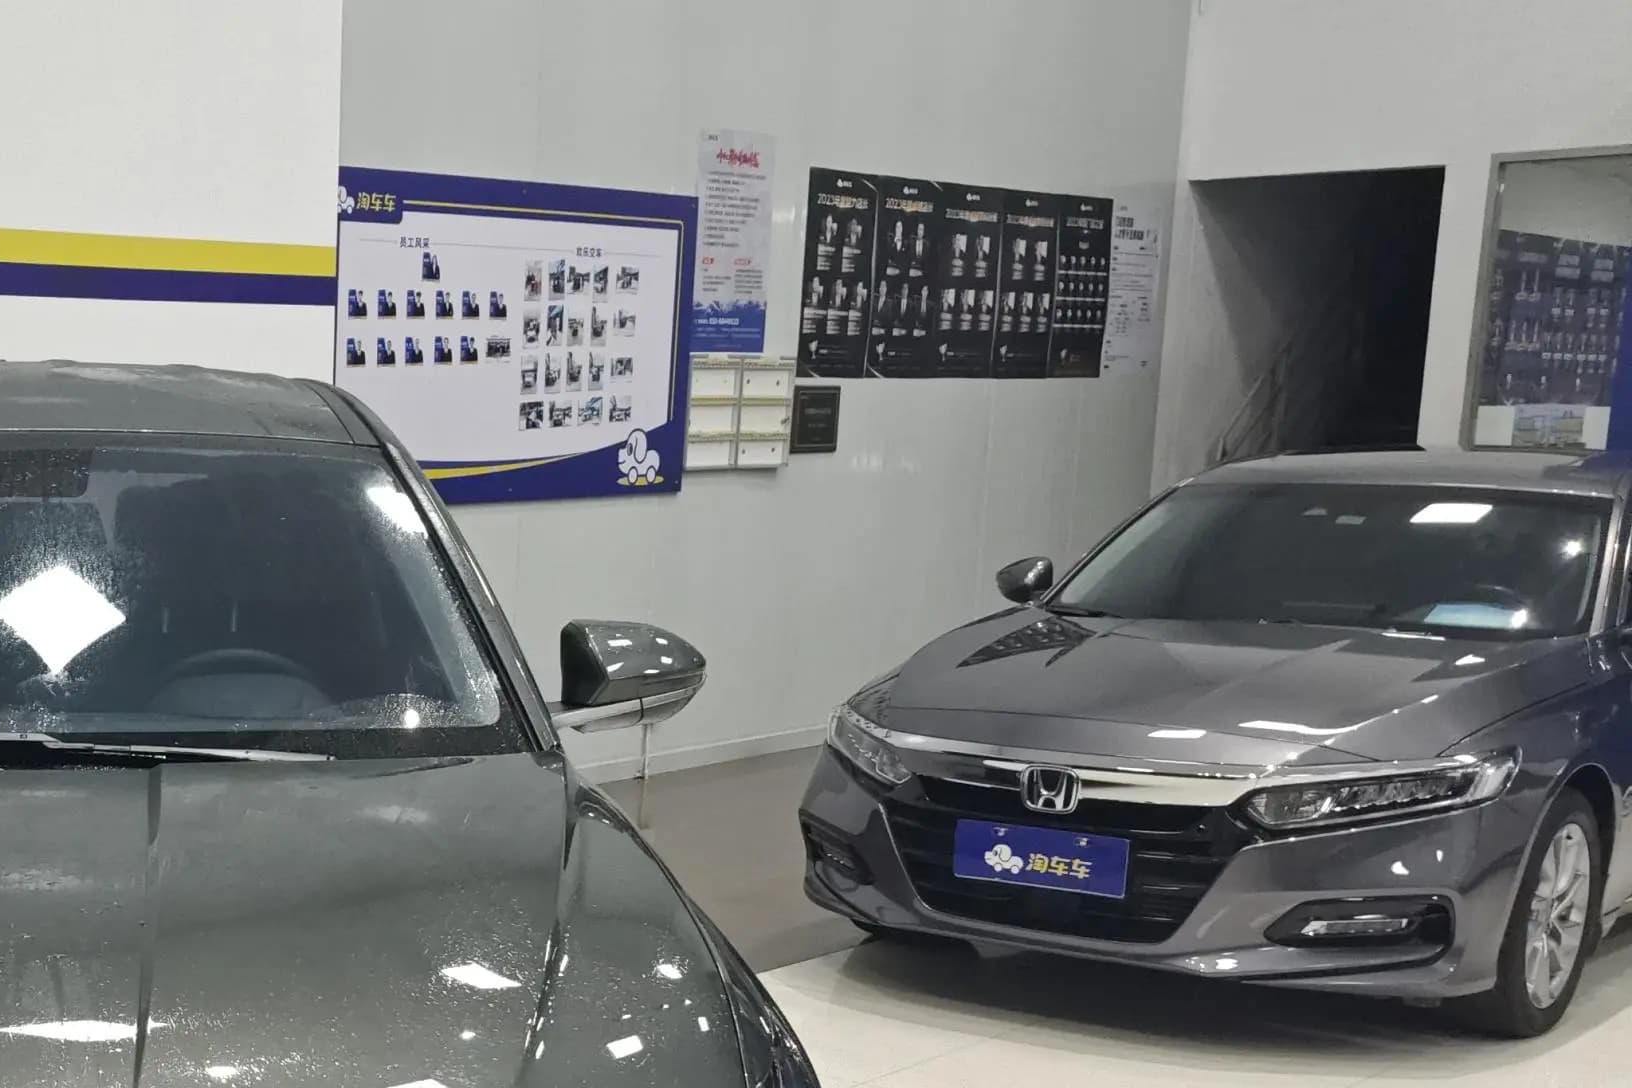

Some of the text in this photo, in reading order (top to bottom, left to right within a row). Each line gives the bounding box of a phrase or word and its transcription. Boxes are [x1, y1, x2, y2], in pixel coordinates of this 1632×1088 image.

[356, 192, 396, 212] 淘车车
[1026, 853, 1092, 879] 淘车车
